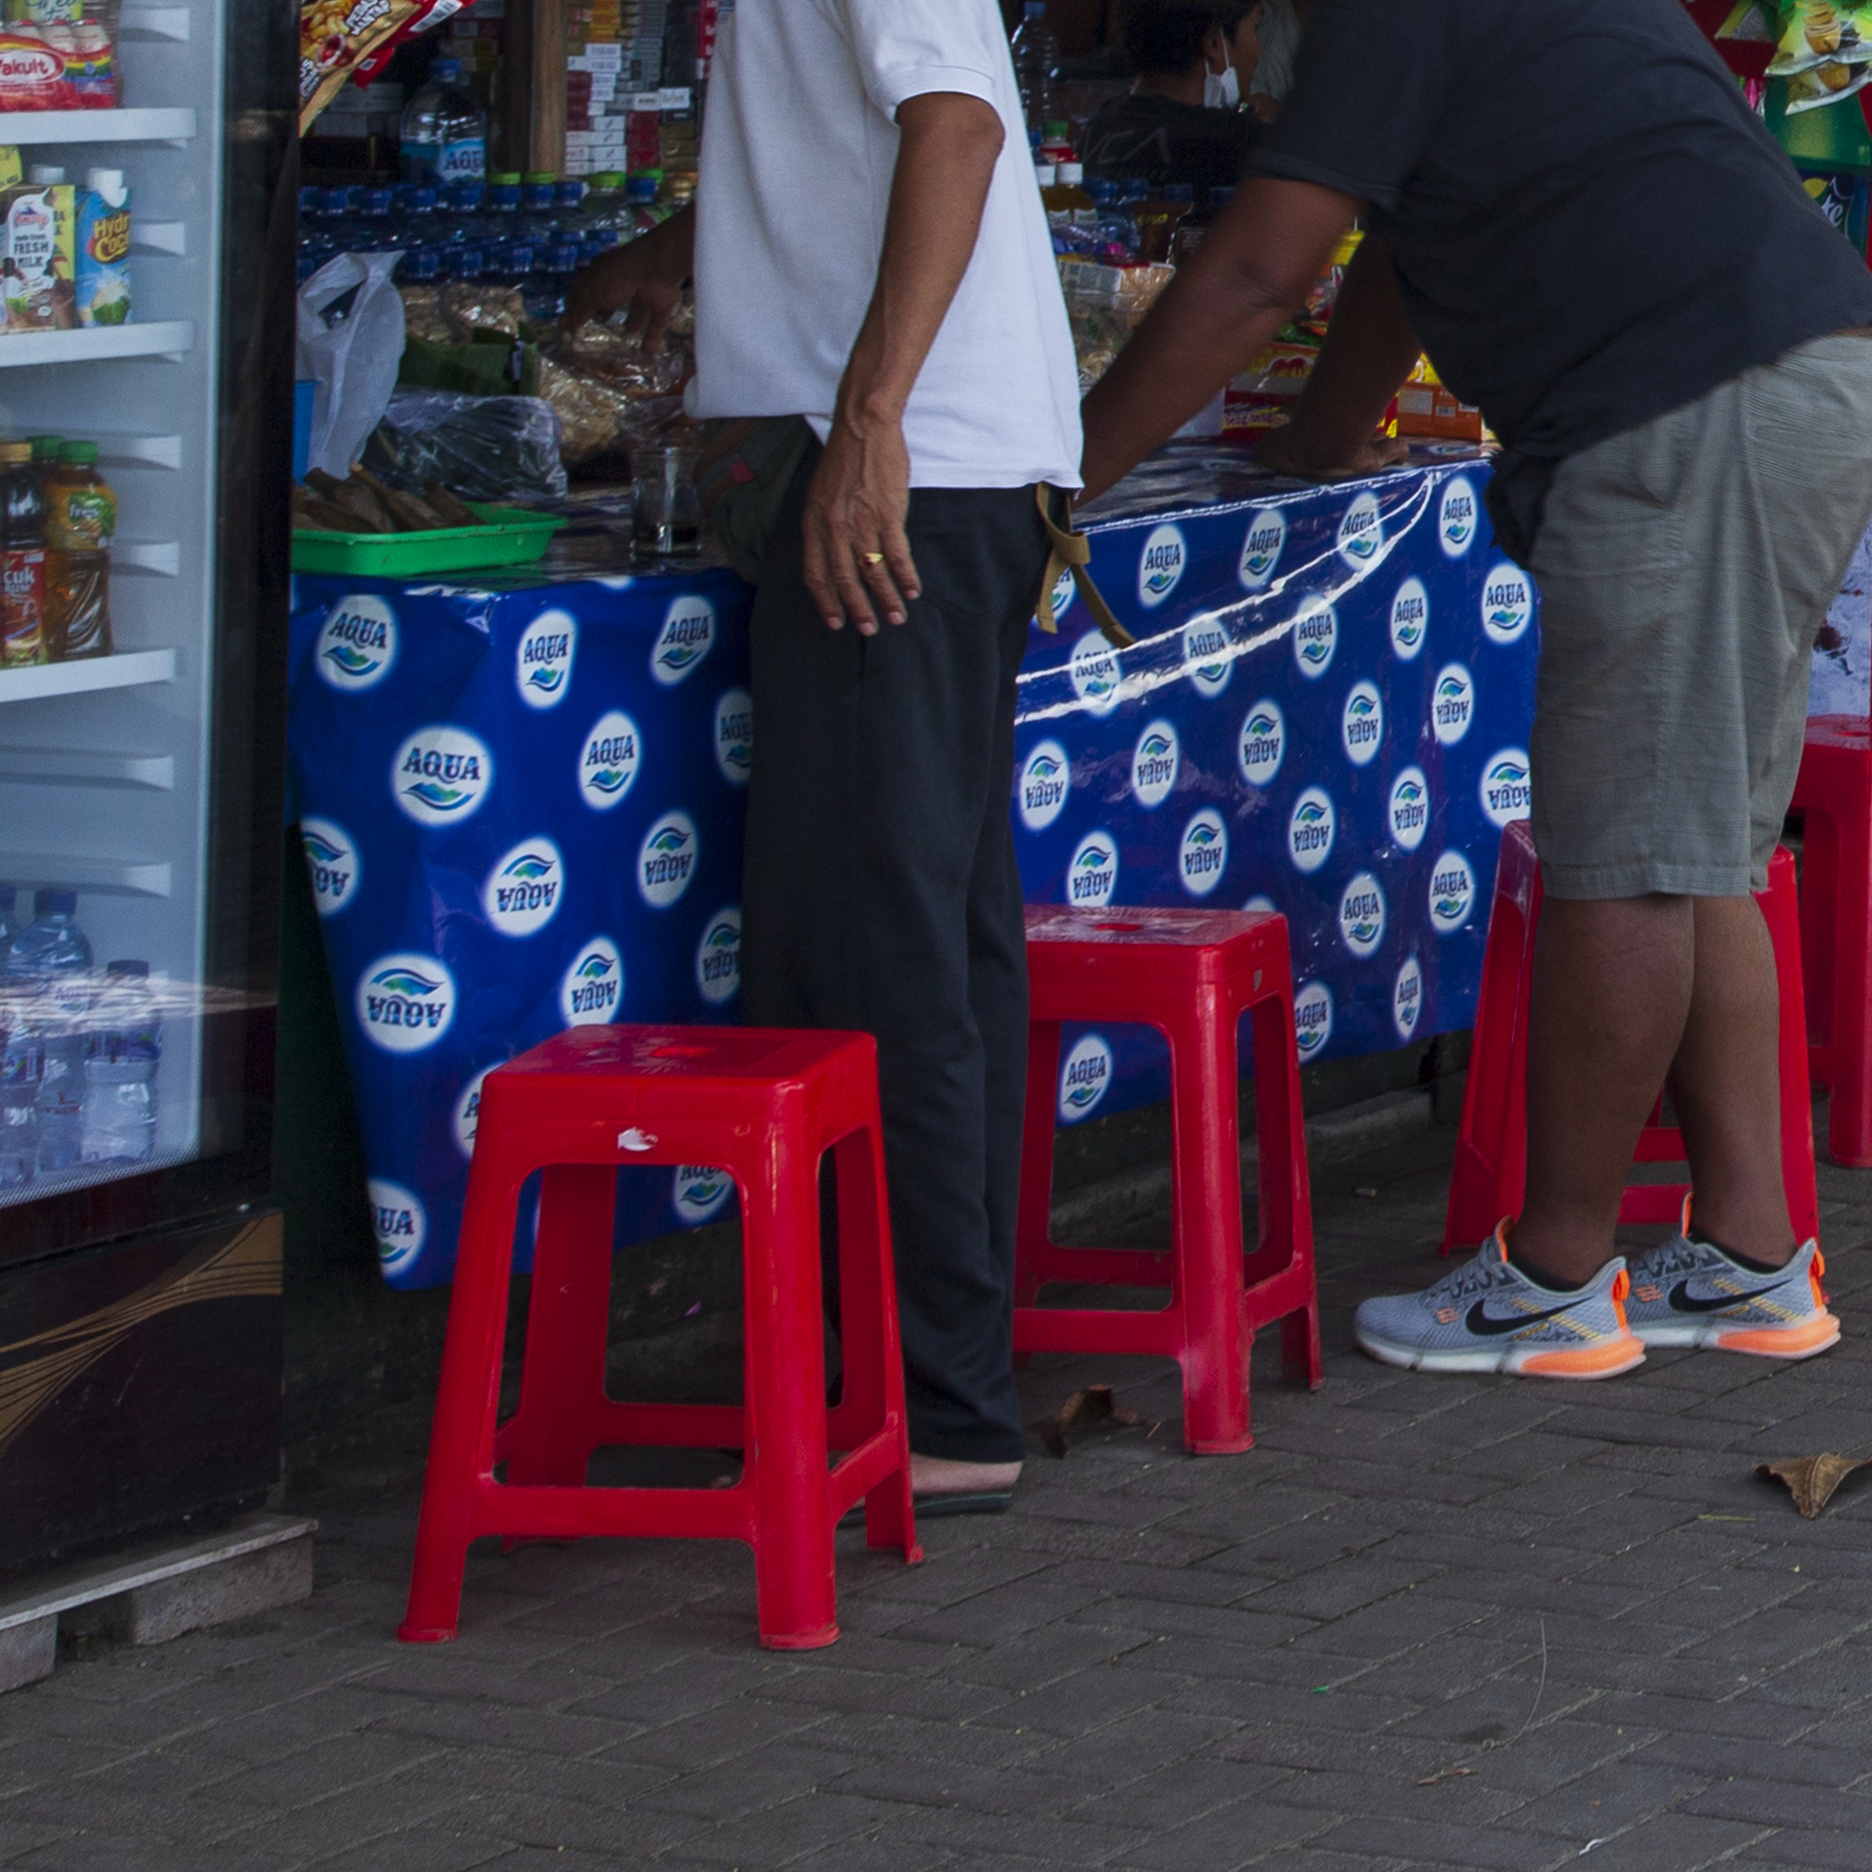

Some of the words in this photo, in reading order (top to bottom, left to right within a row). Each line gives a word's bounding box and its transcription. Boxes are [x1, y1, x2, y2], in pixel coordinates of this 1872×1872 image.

[14, 242, 48, 255] FRESH
[17, 256, 43, 269] MILK
[1443, 497, 1473, 522] AQUA
[1341, 511, 1377, 537] AQUA
[1247, 527, 1281, 554] AQUA
[1145, 545, 1180, 568] AQUA
[1485, 583, 1527, 608] AQUA
[1395, 597, 1424, 623] AQUA
[328, 613, 386, 649] AQUA
[662, 616, 710, 646] AQUA
[1298, 614, 1333, 641] AQUA
[523, 633, 568, 665] AQUA
[1188, 631, 1227, 660] AQUA
[1436, 699, 1470, 726] AQUA
[1347, 718, 1380, 745] AQUA
[586, 735, 635, 766] AQUA
[1244, 737, 1280, 765] AQUA
[402, 748, 480, 784] AQUA
[1137, 758, 1174, 786] AQUA
[1026, 780, 1065, 809] AQUA
[1293, 825, 1331, 853] AQUA
[645, 853, 692, 885] AQUA
[1184, 847, 1222, 876] AQUA
[497, 881, 557, 912] AQUA
[1073, 870, 1113, 900] AQUA
[1432, 871, 1469, 897] AQUA
[1344, 894, 1380, 921] AQUA
[571, 980, 617, 1014] AQUA
[1398, 976, 1419, 1006] AQUA
[368, 995, 446, 1028] AQUA
[1067, 1055, 1106, 1085] AQUA
